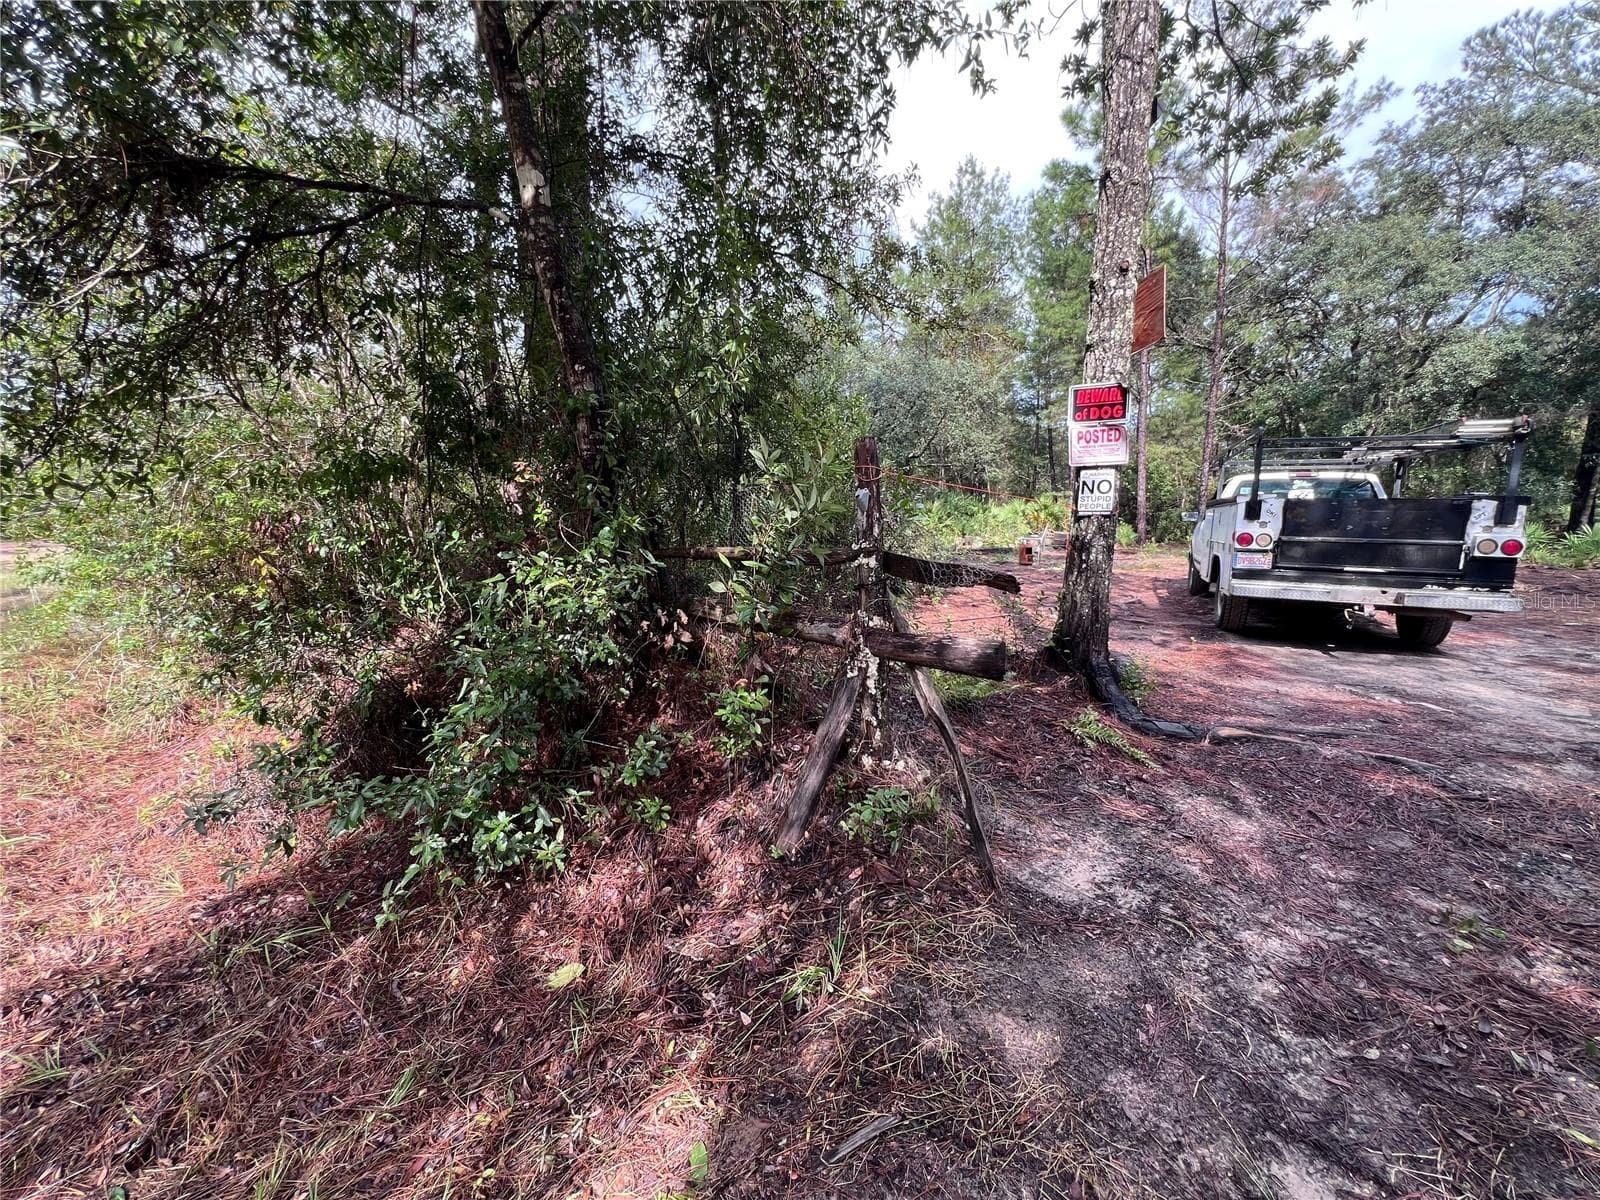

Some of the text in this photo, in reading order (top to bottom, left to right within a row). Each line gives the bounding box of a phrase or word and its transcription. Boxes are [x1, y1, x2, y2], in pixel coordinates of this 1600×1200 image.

[1075, 405, 1123, 421] of DOG
[1077, 428, 1122, 445] POSTED
[1081, 479, 1112, 495] NO
[1079, 495, 1112, 503] STUPID
